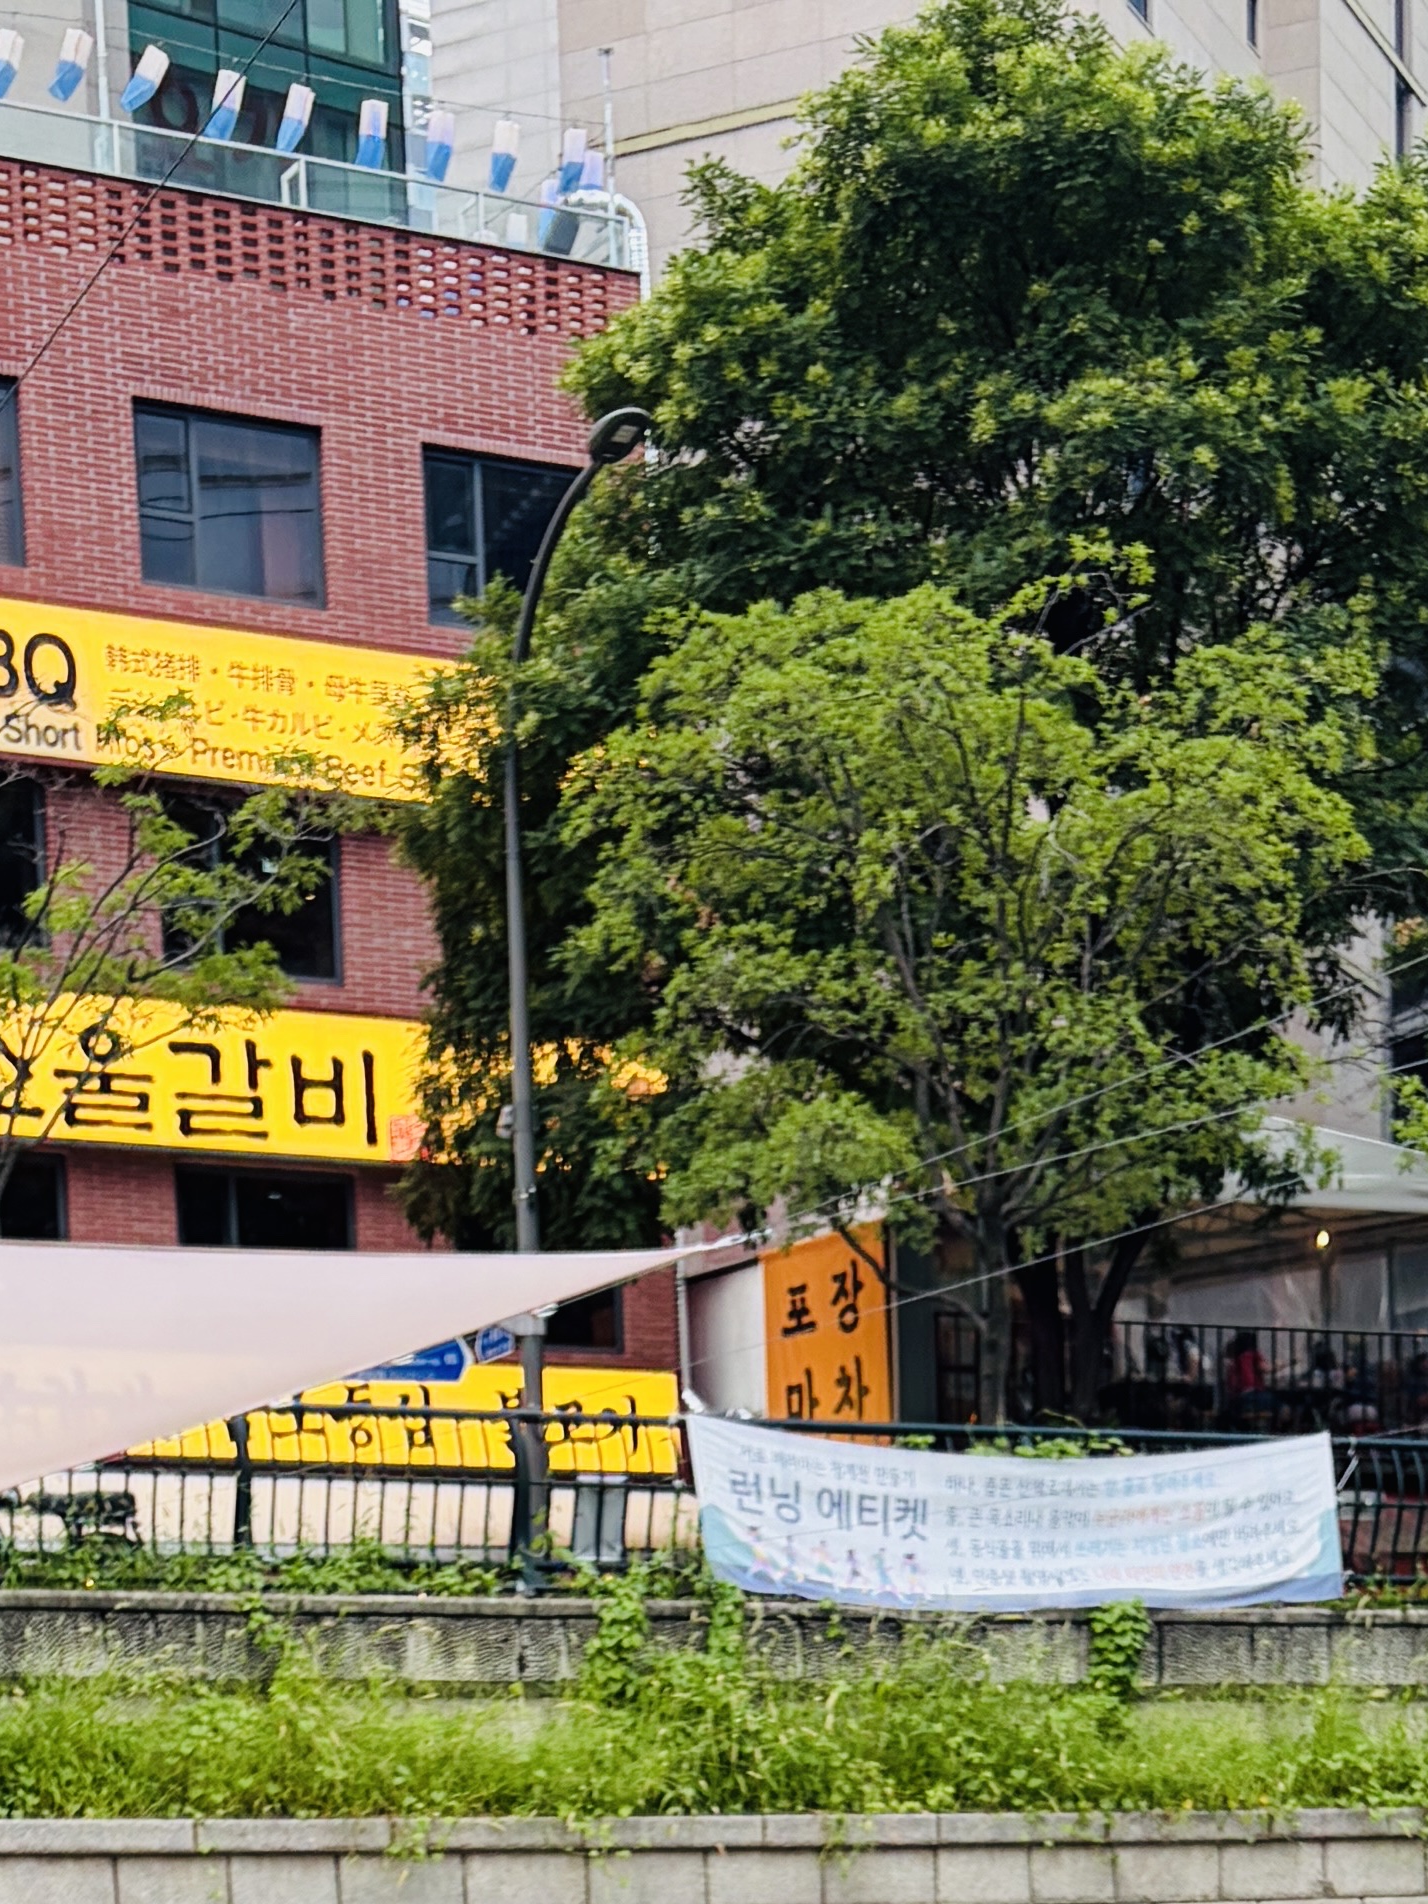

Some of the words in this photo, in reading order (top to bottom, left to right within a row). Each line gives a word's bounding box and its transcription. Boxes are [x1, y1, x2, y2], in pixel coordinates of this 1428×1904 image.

[4, 711, 82, 750] Short
[782, 1259, 864, 1338] 포장
[786, 1355, 870, 1420] 마차
[728, 1468, 802, 1525] 런닝
[817, 1485, 929, 1542] 에티켓
